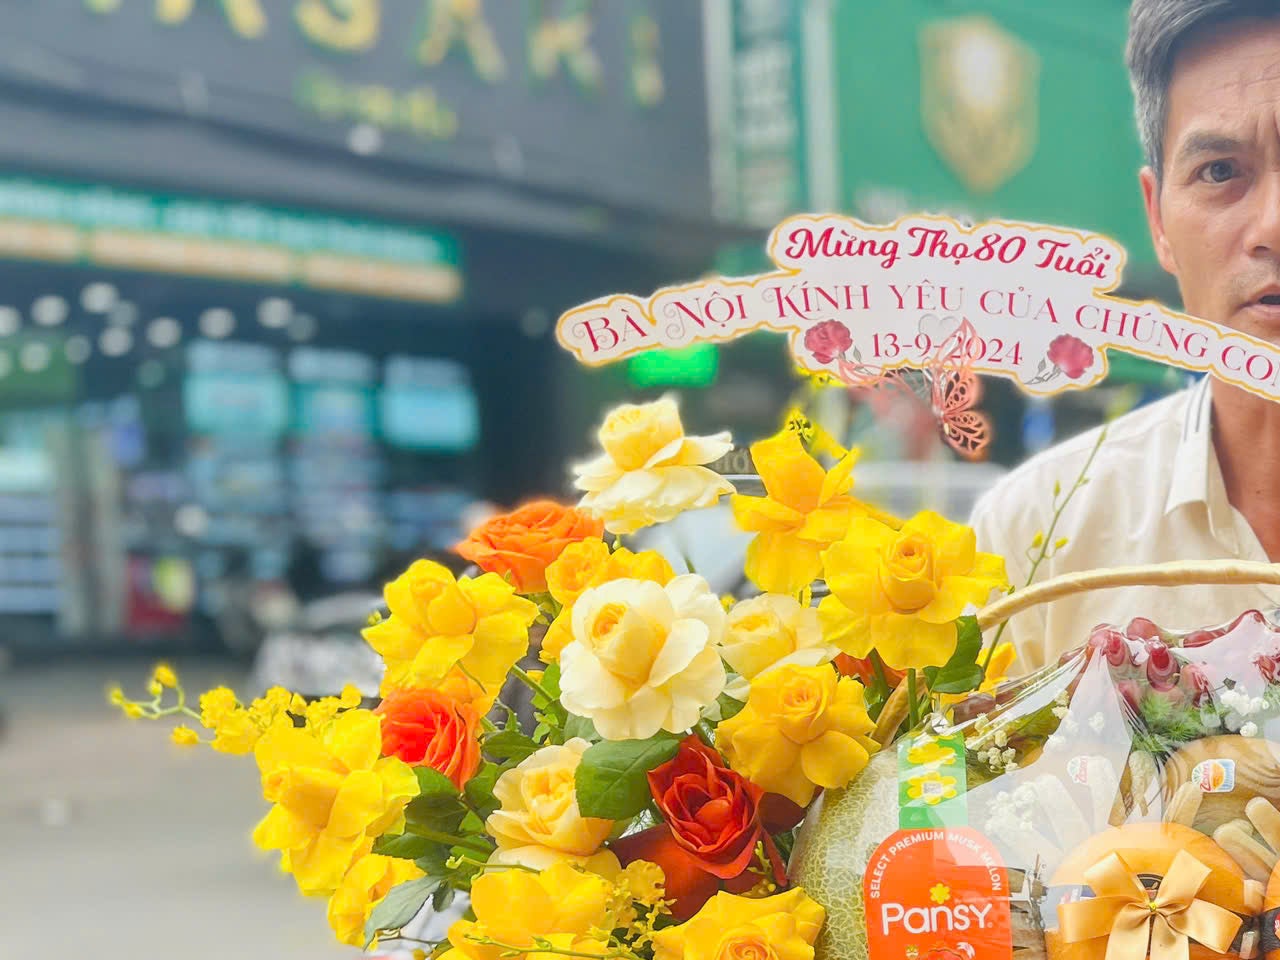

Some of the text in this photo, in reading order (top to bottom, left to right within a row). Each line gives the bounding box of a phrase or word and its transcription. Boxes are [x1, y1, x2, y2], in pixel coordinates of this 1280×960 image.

[785, 226, 901, 269] Mừng
[1034, 238, 1111, 279] Tuổi
[571, 308, 648, 352] BÀ
[662, 290, 748, 341] NỘI
[761, 281, 870, 321] KÍNH
[888, 278, 964, 311] YÊU
[979, 286, 1059, 324] CỦA
[1075, 304, 1209, 358] CHÚNG
[872, 332, 1024, 365] 13-9-2024
[870, 831, 1003, 899] SELECT PREMIUM MUSK MELON
